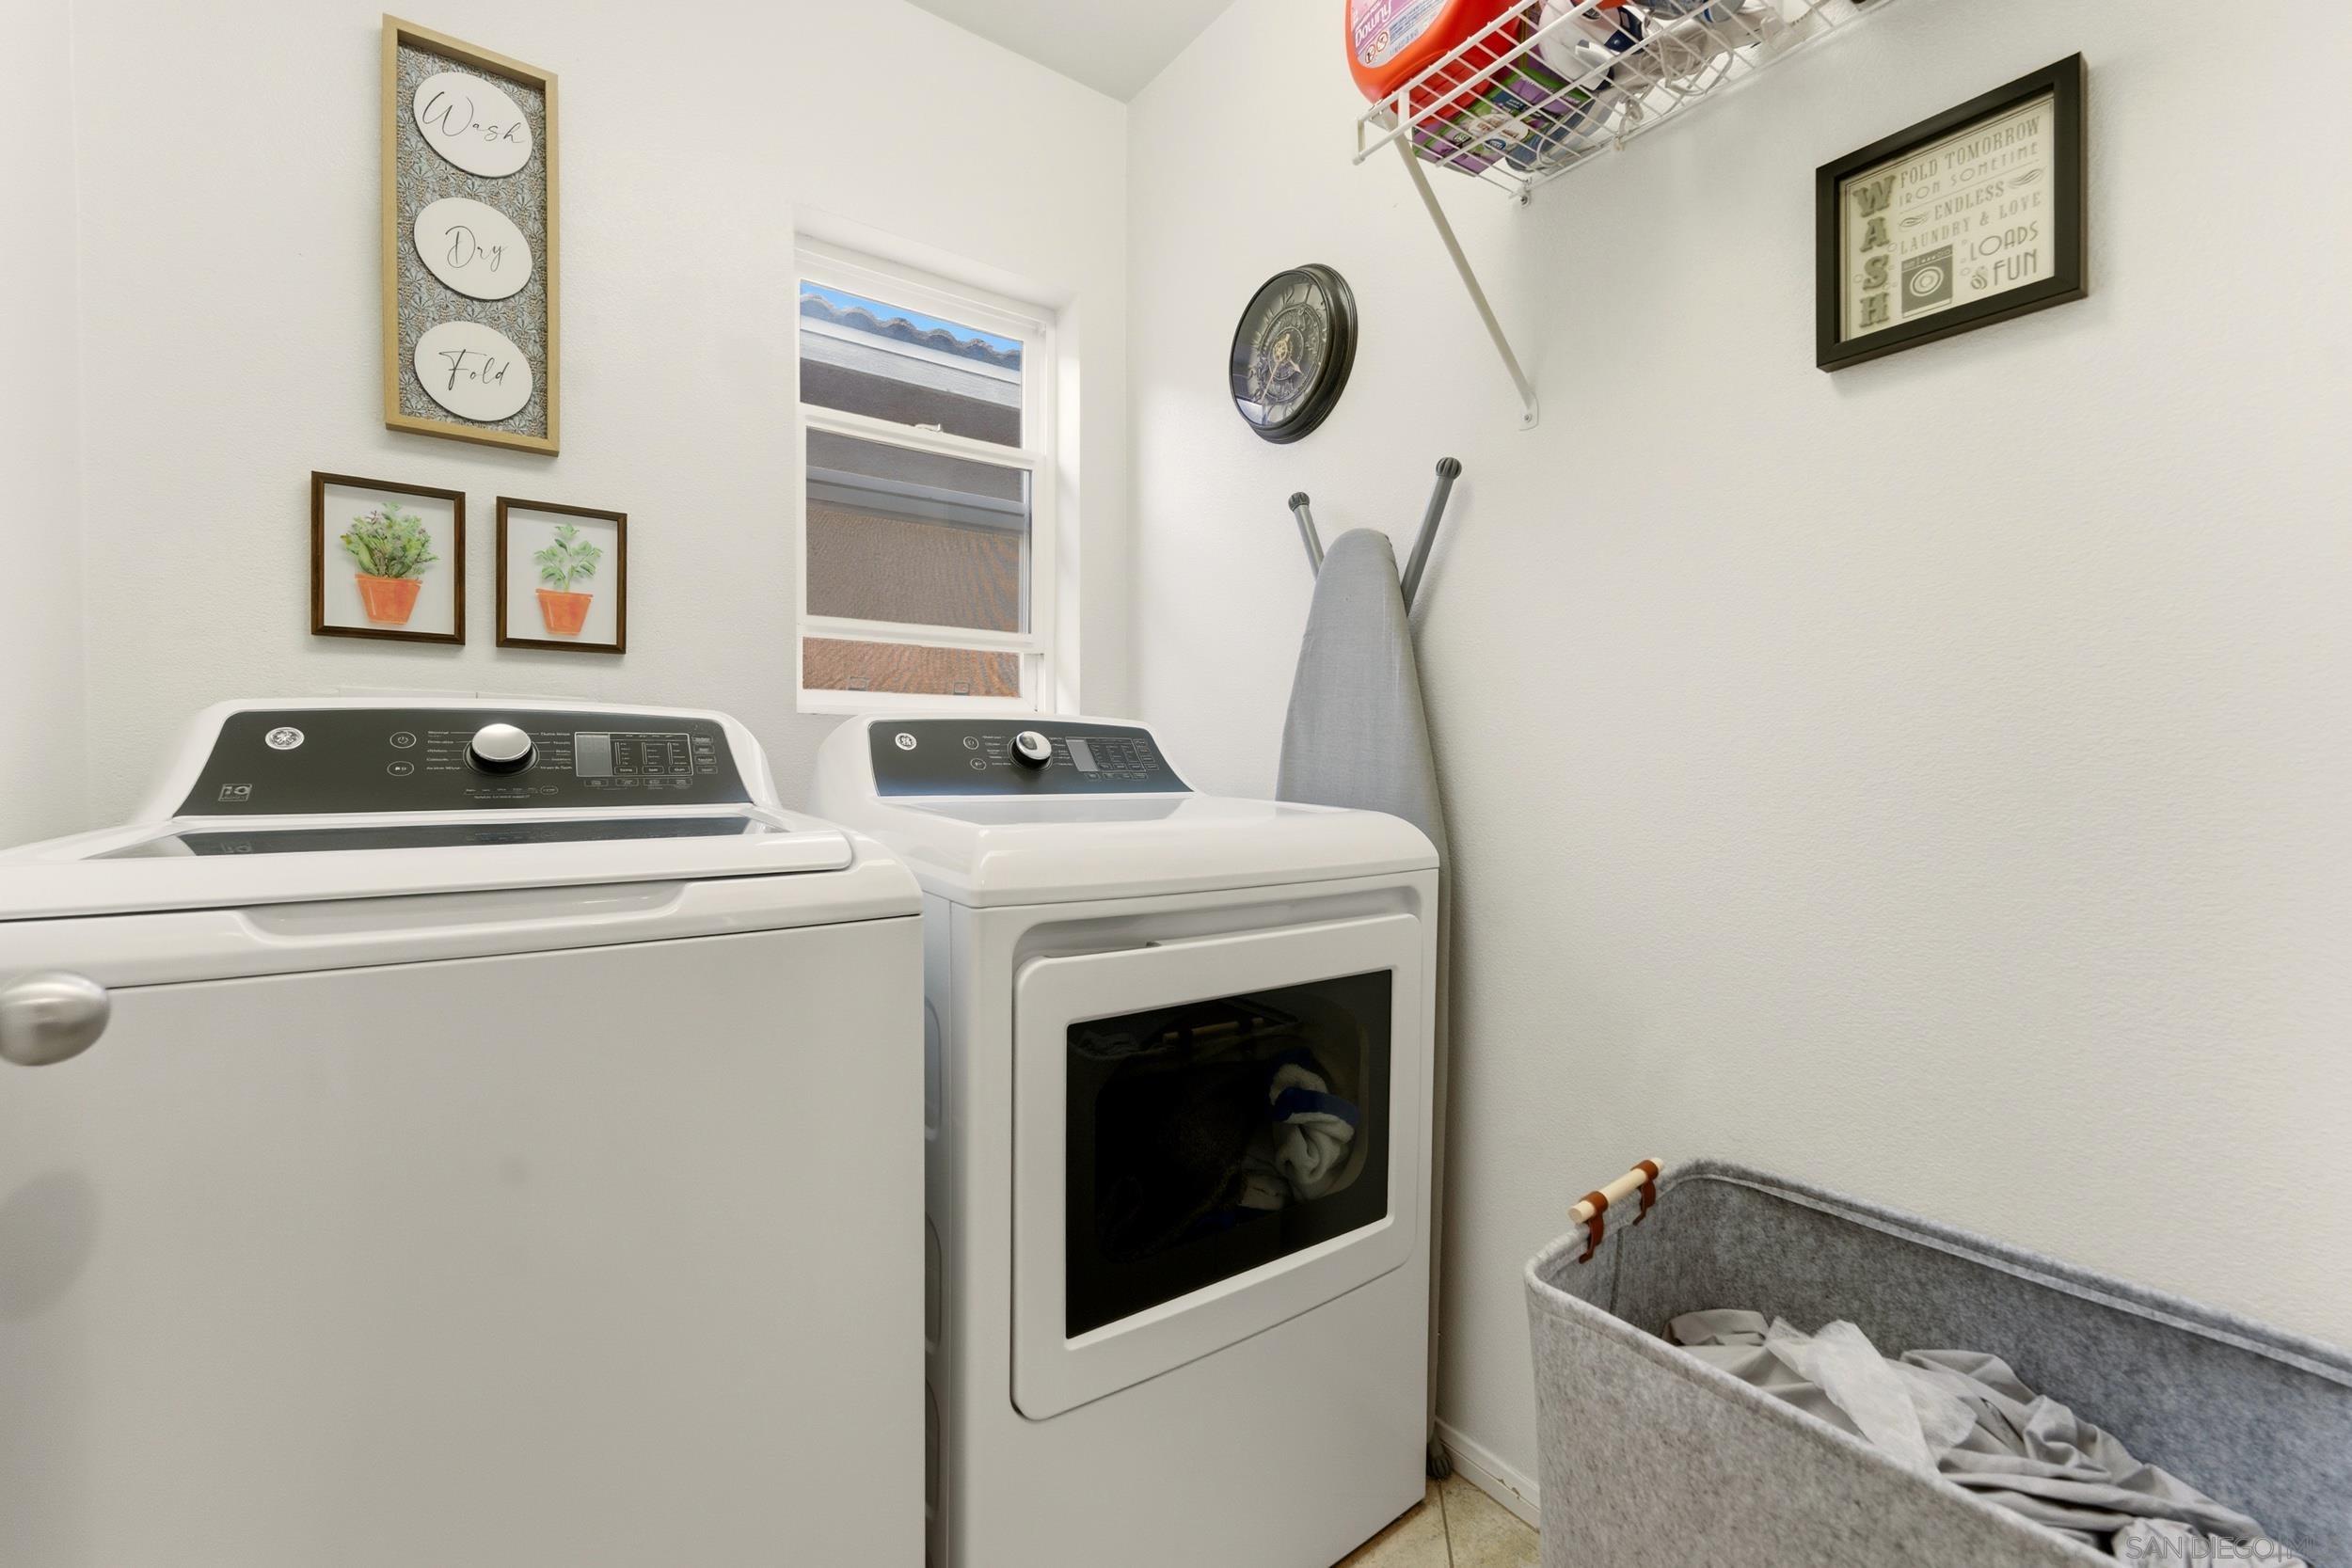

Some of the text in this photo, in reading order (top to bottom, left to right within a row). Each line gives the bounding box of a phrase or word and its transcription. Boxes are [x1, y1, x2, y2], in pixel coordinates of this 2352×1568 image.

[1355, 0, 1391, 48] Downy
[421, 90, 525, 144] Wash
[1899, 142, 2040, 207] IRON SOMETIME
[1900, 115, 2041, 189] FOLD TOMORROW
[1900, 191, 2042, 255] LAUNDRY & LOVE
[1934, 181, 2006, 220] ENDLESS
[444, 225, 507, 273] Dry
[1851, 175, 1897, 328] WASH
[1970, 220, 2040, 261] LOADS
[1993, 248, 2039, 286] FUN
[438, 348, 510, 391] Fold
